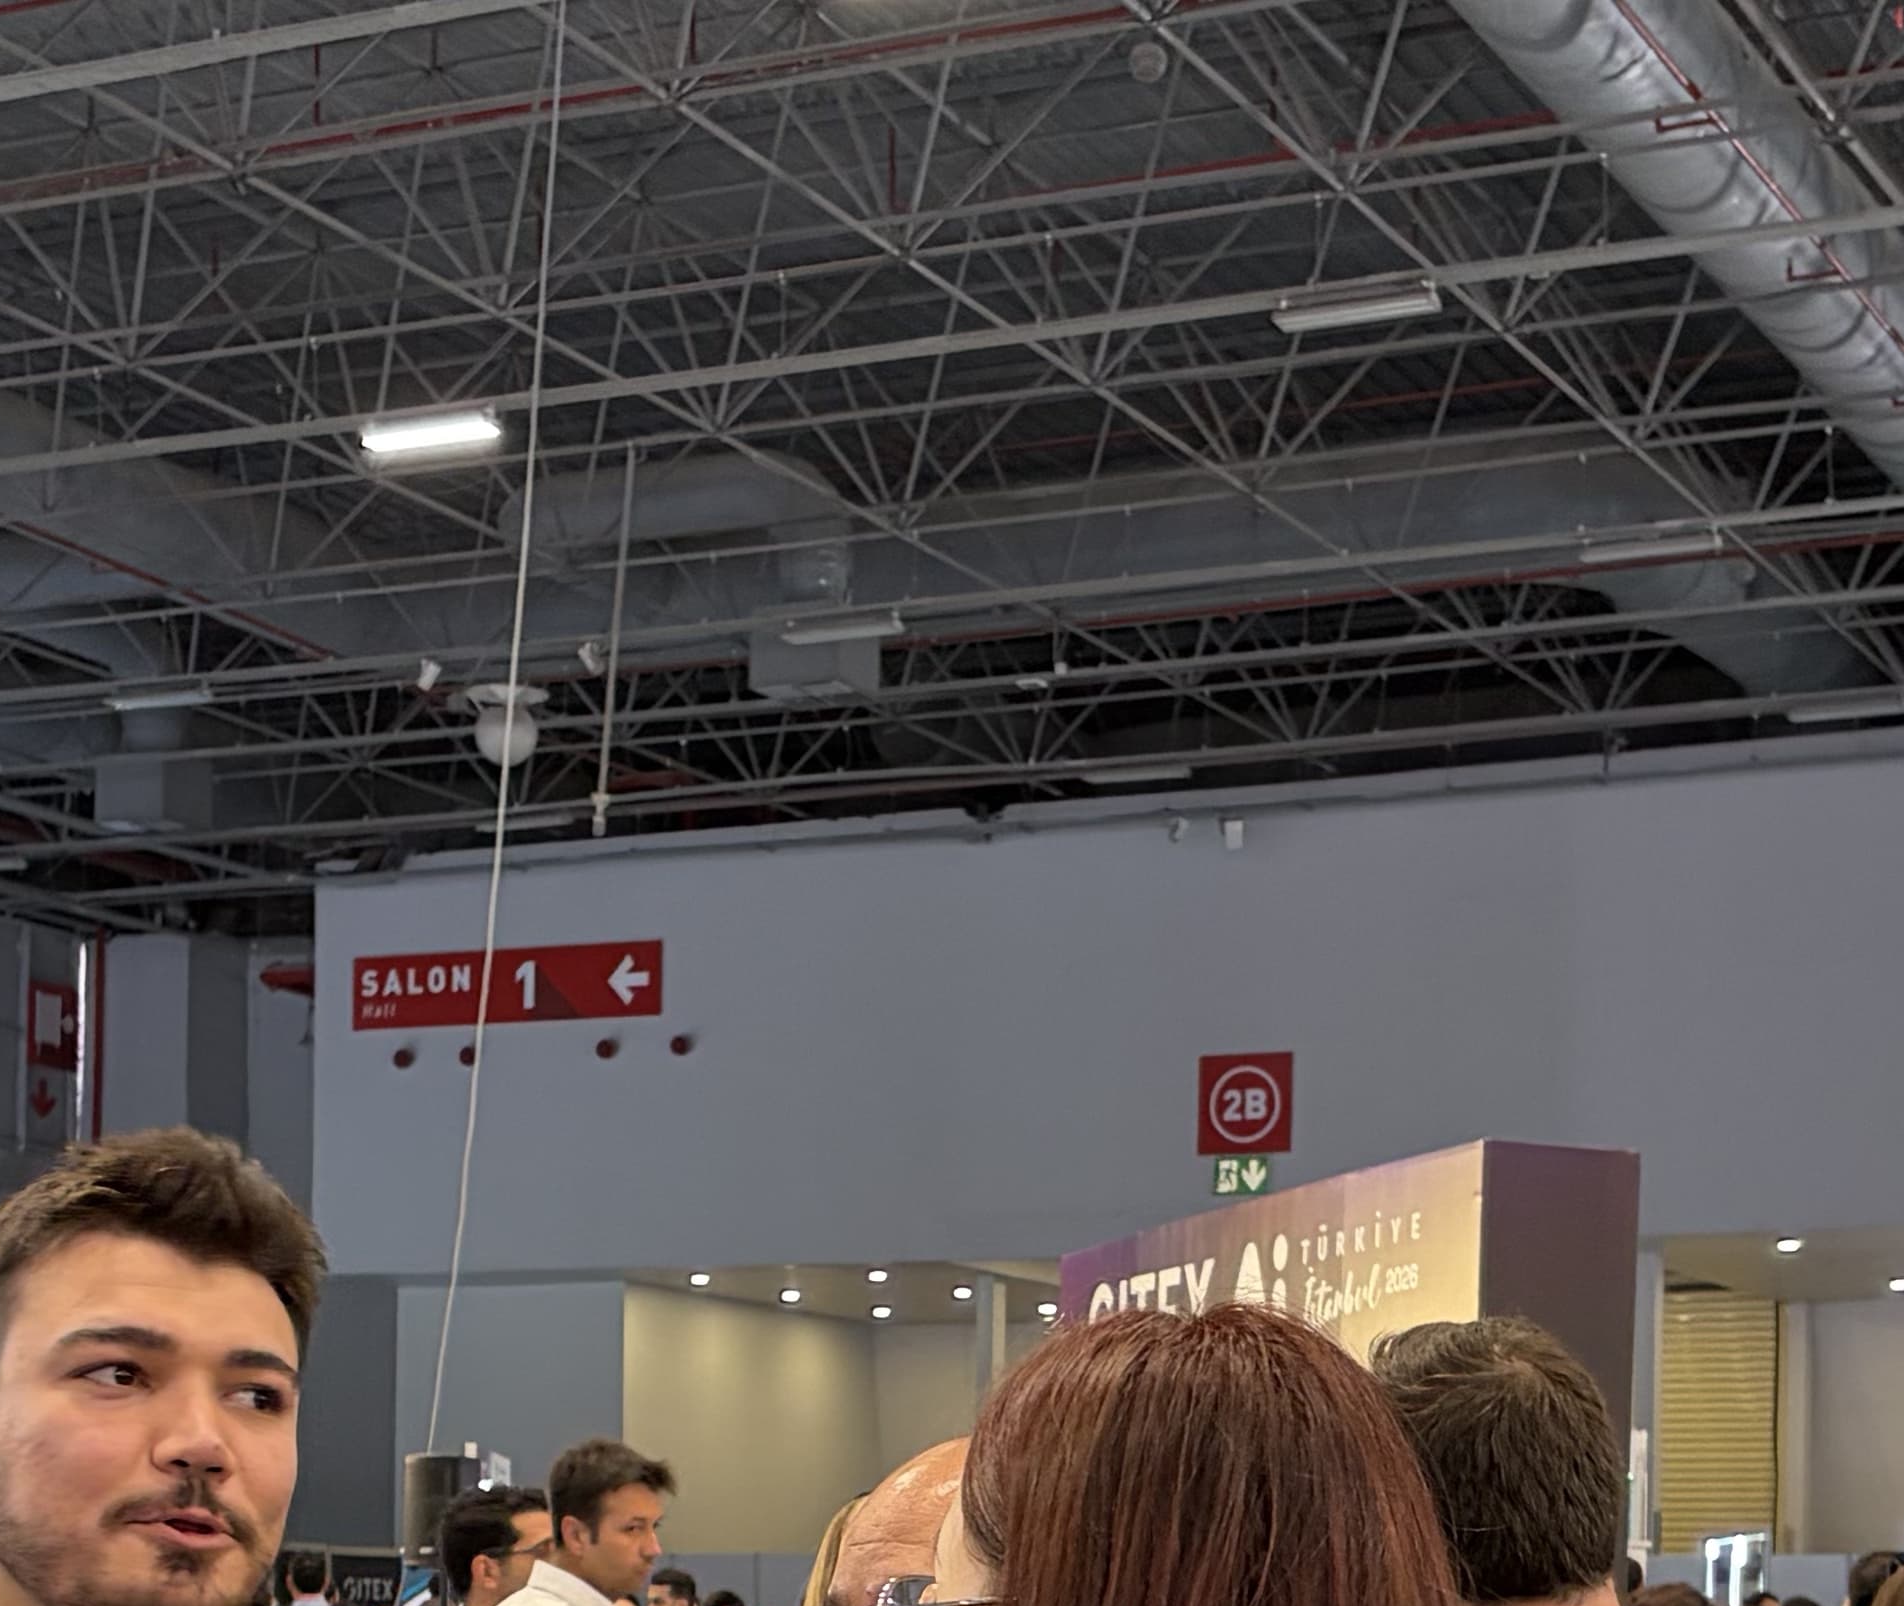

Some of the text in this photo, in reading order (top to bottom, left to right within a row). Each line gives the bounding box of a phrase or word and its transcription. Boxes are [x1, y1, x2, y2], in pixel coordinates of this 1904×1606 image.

[361, 960, 536, 1010] SALON 1
[1223, 1087, 1267, 1122] 2B
[1301, 1211, 1421, 1265] TÜRKİYE
